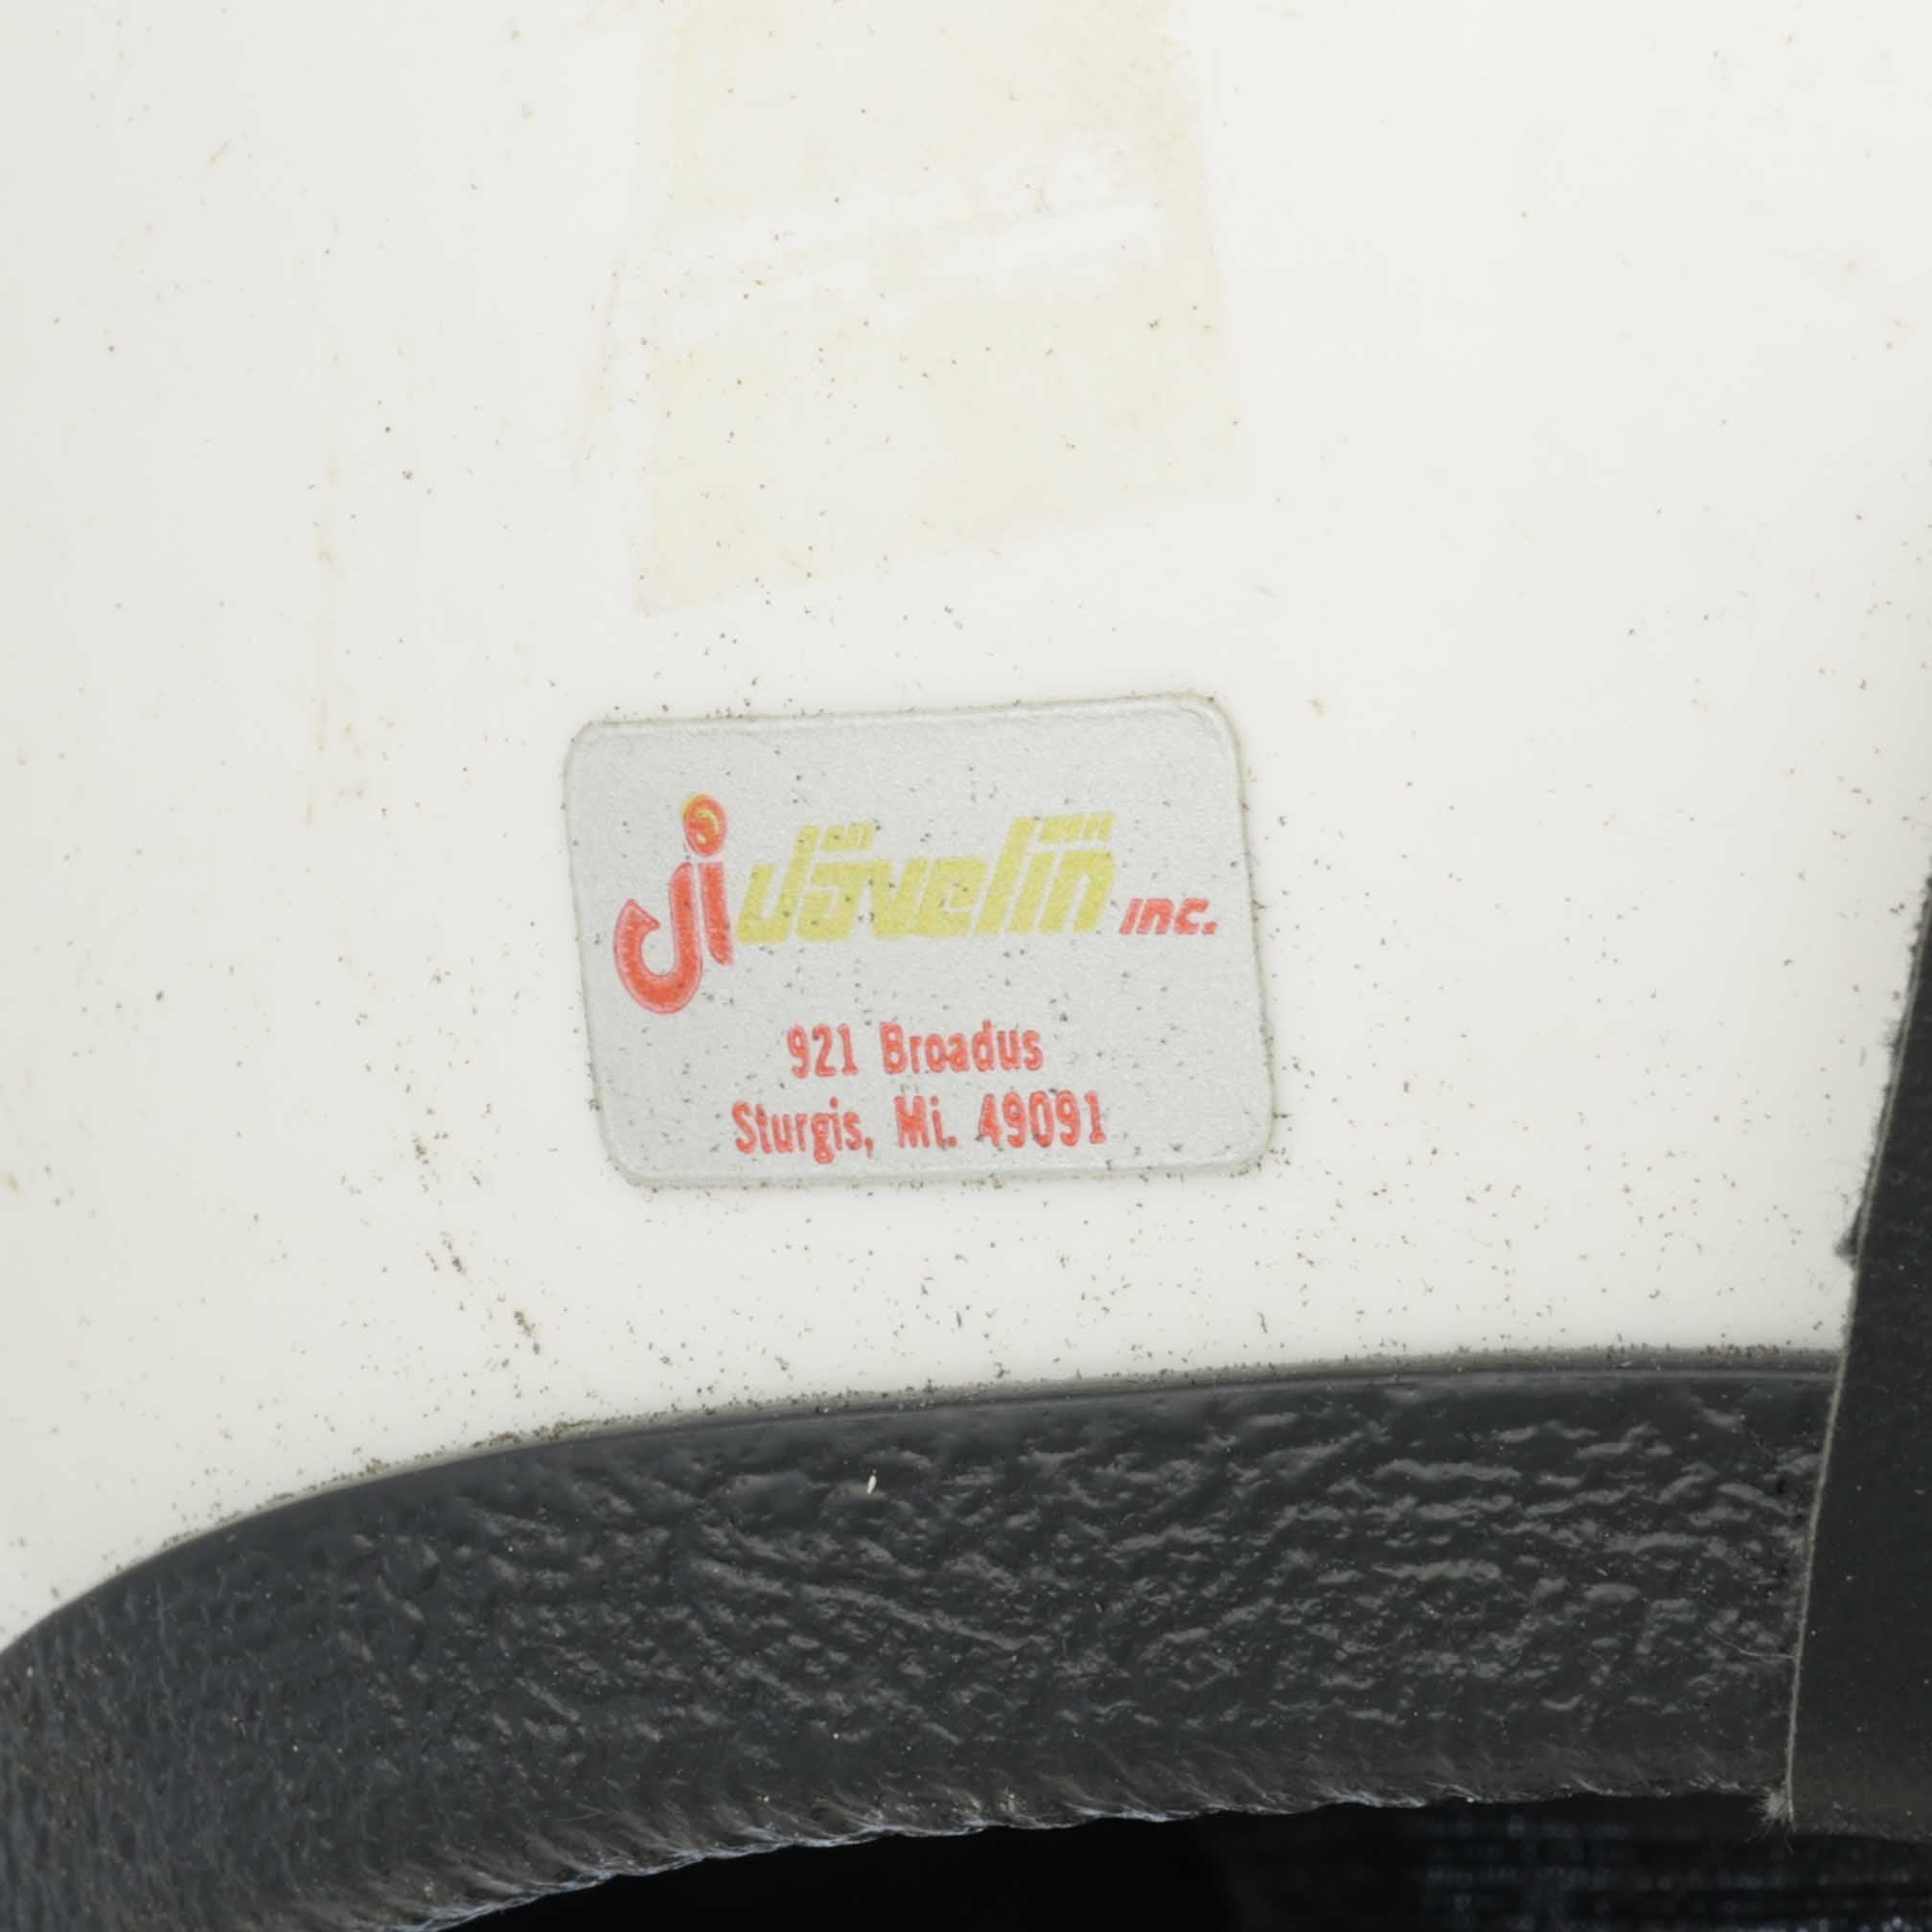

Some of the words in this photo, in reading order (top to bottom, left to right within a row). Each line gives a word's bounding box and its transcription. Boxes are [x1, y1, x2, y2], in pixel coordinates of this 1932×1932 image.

[786, 1024, 859, 1079] 921
[879, 1020, 1045, 1075] Broadus
[731, 1096, 875, 1164] Sturgis,
[894, 1094, 958, 1149] Mi.
[978, 1090, 1107, 1150] 49091
